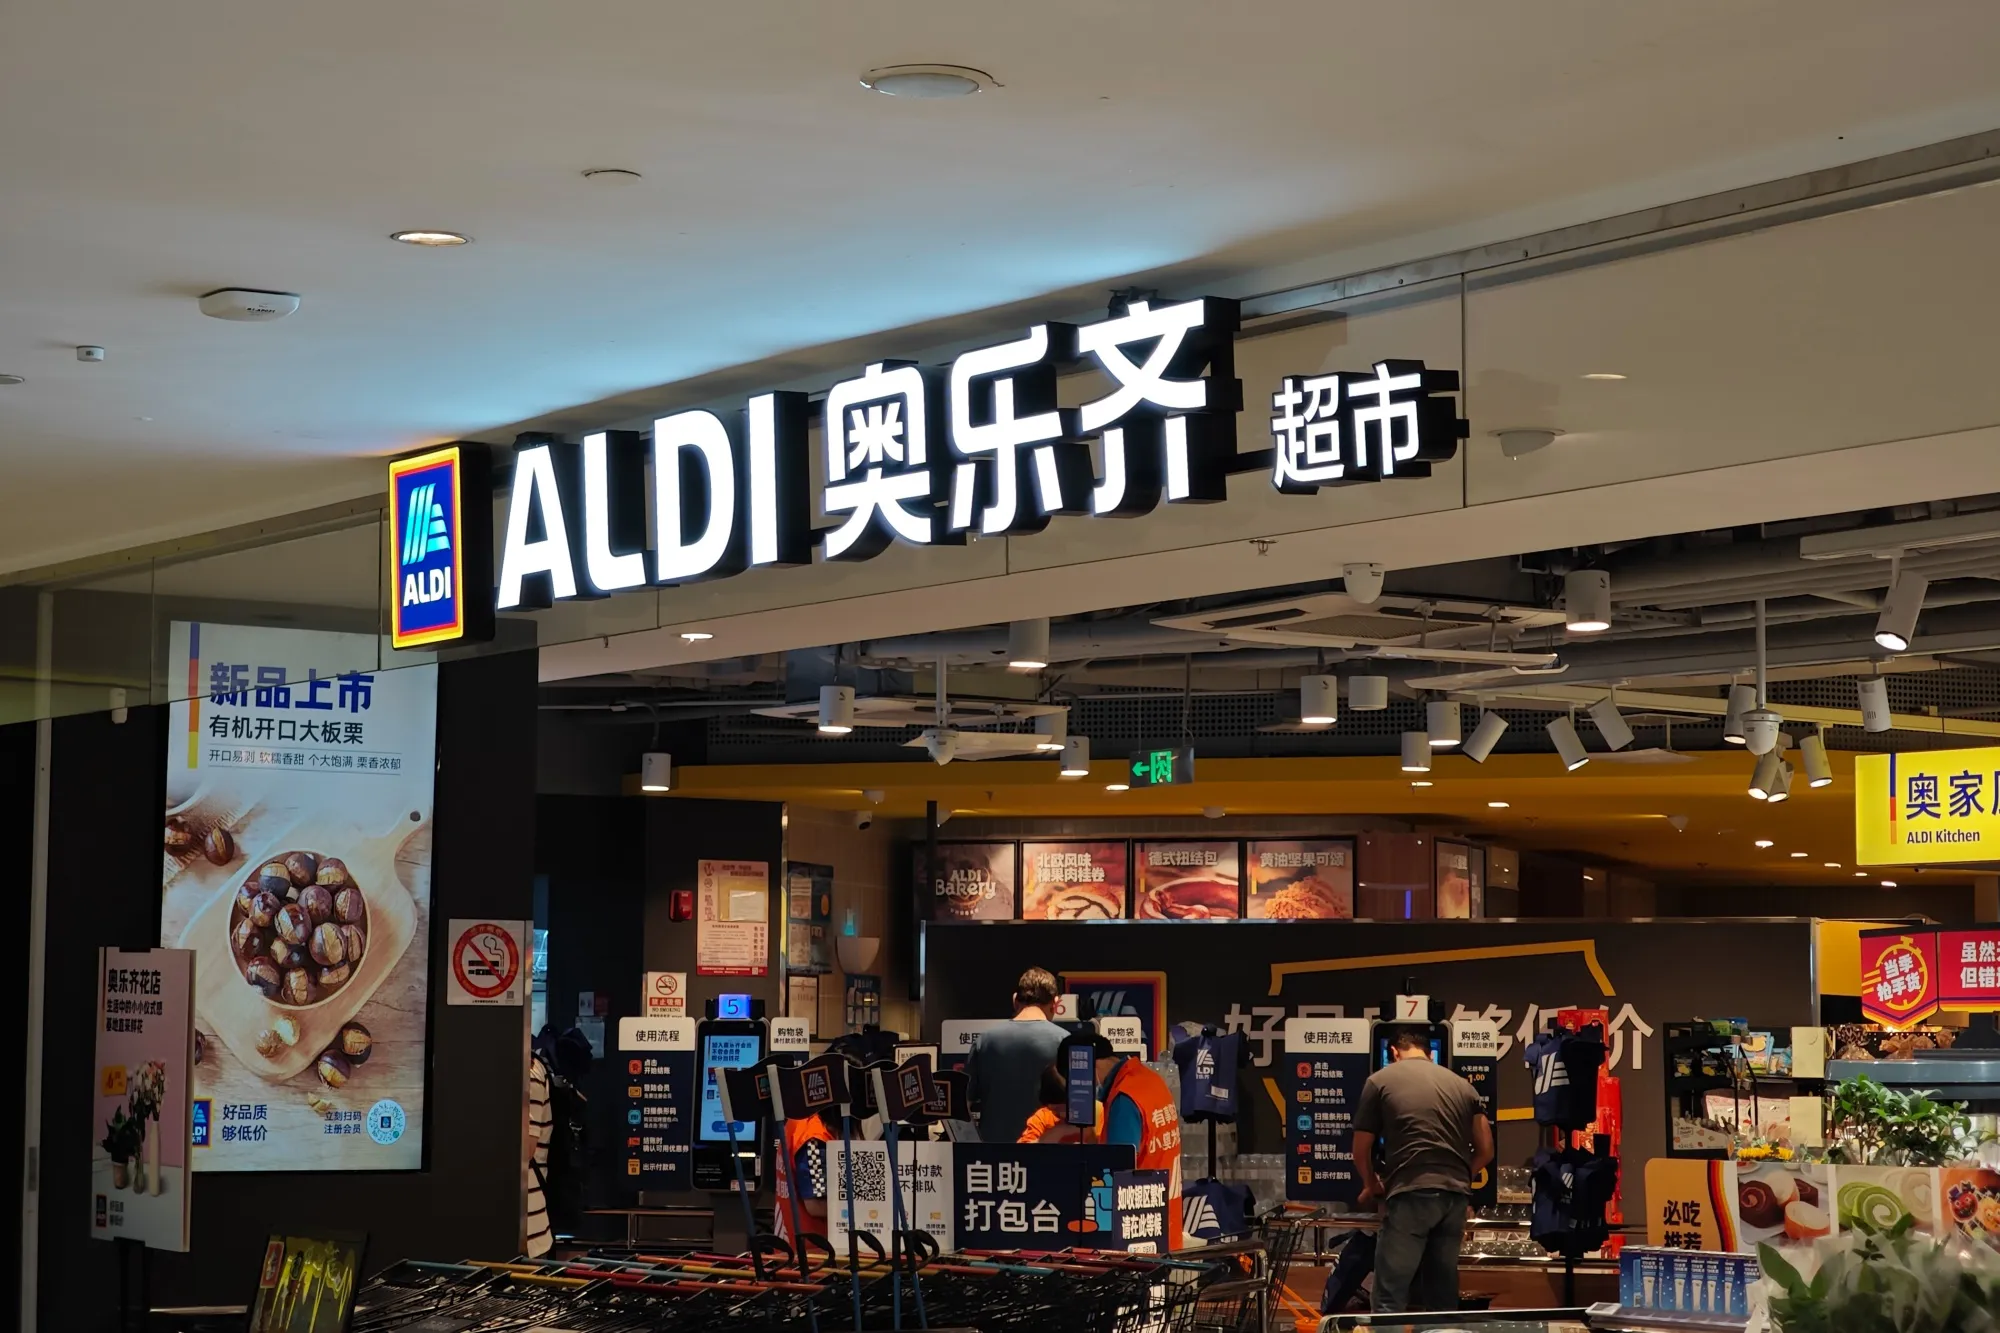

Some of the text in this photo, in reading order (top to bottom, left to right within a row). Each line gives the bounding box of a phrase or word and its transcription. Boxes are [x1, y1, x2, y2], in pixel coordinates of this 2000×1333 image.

[825, 299, 1207, 558] 奥乐齐
[1271, 364, 1422, 489] 超市
[497, 393, 778, 610] ALDI
[403, 572, 451, 607] ALDI
[210, 662, 374, 713] 新品上市
[209, 715, 363, 744] 有机开口大板栗
[308, 754, 353, 768] 个大饱满
[357, 756, 400, 770] 栗香浓郁
[1906, 770, 2000, 820] 奥家
[1907, 829, 1980, 844] ALDI Kitchen
[1037, 853, 1091, 867] 北欧风味
[1149, 851, 1218, 866] 德式扭结包
[1260, 851, 1345, 867] 黄油坚果可颂
[950, 869, 981, 882] ALDI
[935, 878, 996, 900] Bakery
[1961, 941, 2000, 962] 虽然
[1884, 954, 1914, 979] 当季
[108, 968, 161, 995] 奥乐齐花店
[1960, 966, 2000, 988] 但错
[1877, 972, 1921, 1001] 抢手货
[728, 999, 739, 1015] 5
[1053, 999, 1066, 1015] 6
[1406, 1000, 1418, 1017] 7
[636, 1030, 680, 1042] 使用流程
[778, 1028, 804, 1037] 购物袋
[959, 1032, 981, 1045] 使用
[1107, 1028, 1135, 1037] 购物袋
[1304, 1031, 1353, 1044] 使用流程
[1461, 1031, 1491, 1041] 购物袋
[1196, 1066, 1214, 1075] LDI
[1314, 1062, 1329, 1070] 点击
[1314, 1070, 1344, 1079] 开始结账
[809, 1088, 826, 1097] ALDI
[906, 1088, 919, 1096] ALDI
[223, 1104, 267, 1120] 好品质
[325, 1111, 362, 1121] 立刻扫码
[193, 1126, 206, 1136] DI
[222, 1125, 268, 1141] 够低价
[324, 1125, 361, 1134] 注册会员
[1314, 1152, 1354, 1160] 确认可用优
[643, 1163, 676, 1171] 出示付款码
[967, 1161, 1027, 1194] 自助
[1315, 1172, 1351, 1180] 出示付款码
[900, 1181, 936, 1193] 不排队
[1117, 1183, 1166, 1211] 如收银区繁忙
[965, 1199, 1061, 1233] 打包台
[1664, 1200, 1701, 1226] 必吃
[1122, 1213, 1162, 1239] 请在此等候
[1664, 1231, 1702, 1250] 推荐
